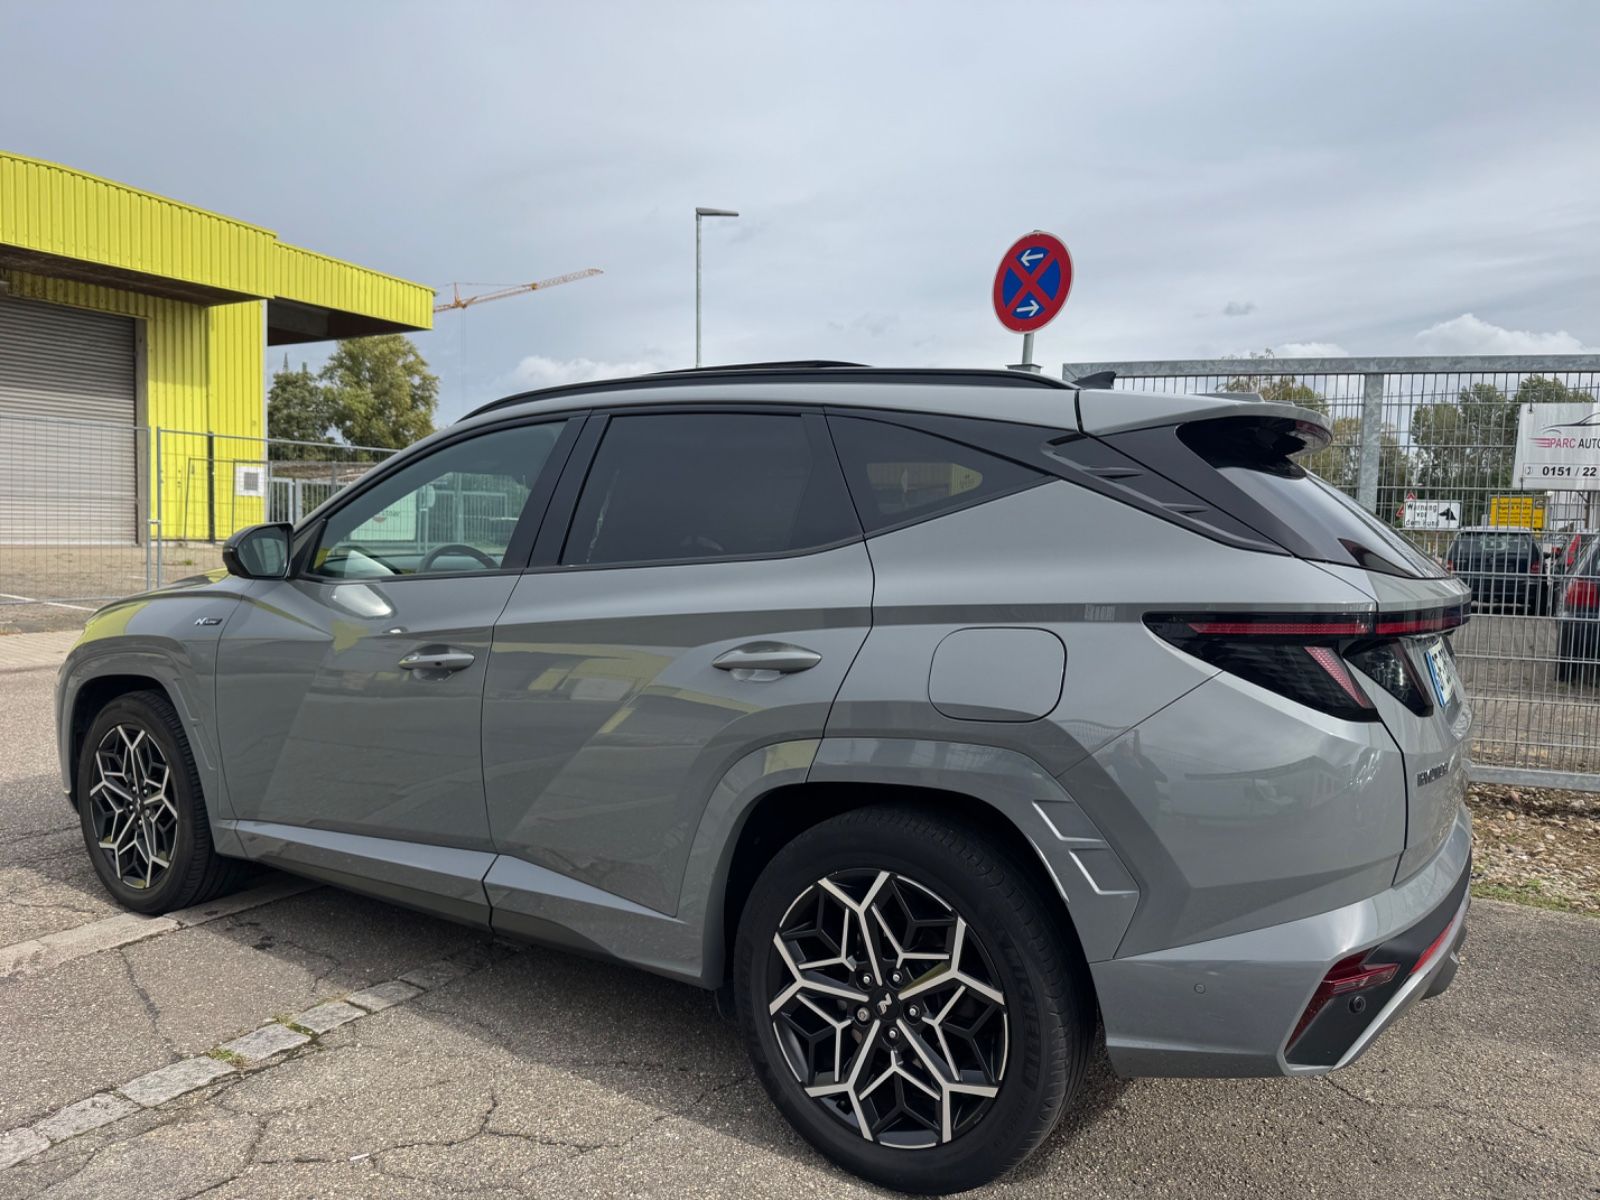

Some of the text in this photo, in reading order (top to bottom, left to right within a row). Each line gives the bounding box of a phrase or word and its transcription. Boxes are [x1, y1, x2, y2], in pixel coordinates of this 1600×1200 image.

[1550, 438, 1576, 448] PARC
[1542, 466, 1571, 477] 0151
[1582, 466, 1597, 477] 22
